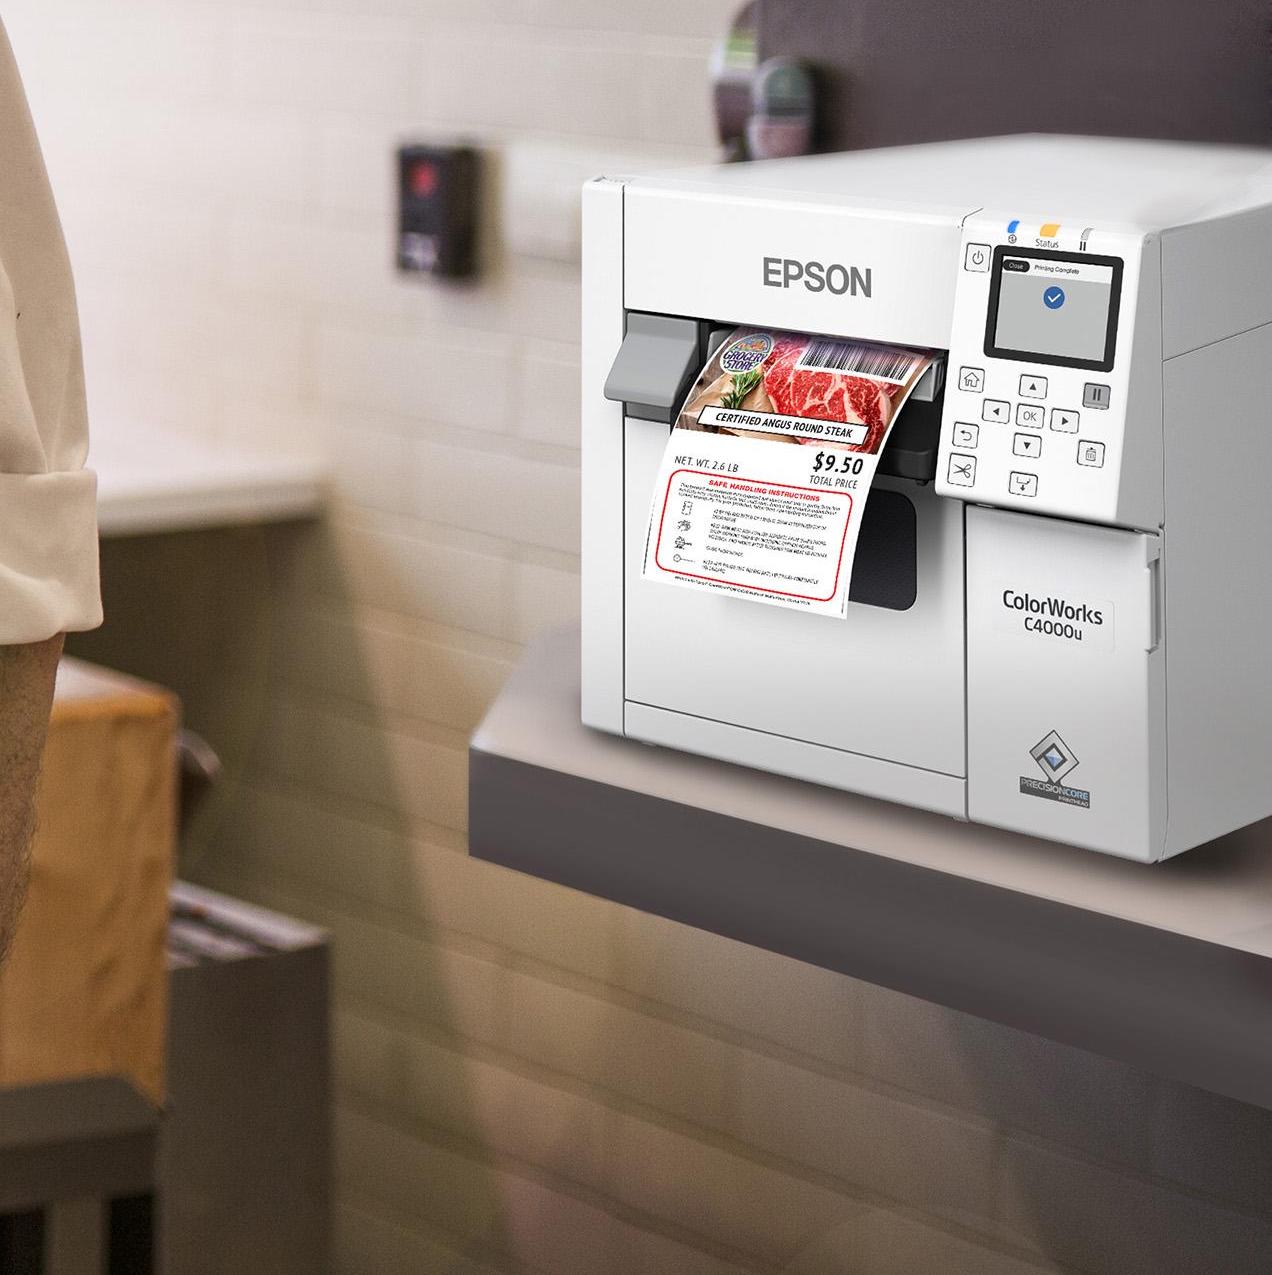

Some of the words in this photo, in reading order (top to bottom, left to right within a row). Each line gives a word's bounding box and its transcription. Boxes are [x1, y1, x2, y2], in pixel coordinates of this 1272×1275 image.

[1035, 238, 1060, 249] Status
[763, 257, 872, 298] EPSON
[1034, 264, 1055, 273] Printing
[1055, 266, 1080, 275] Complete
[723, 350, 768, 363] GROCERY
[724, 359, 755, 371] STORE
[715, 412, 761, 426] CERTIFIED
[762, 418, 793, 431] ANGUS
[793, 421, 824, 434] ROUND
[824, 425, 853, 438] STEAK
[1023, 410, 1037, 422] OK
[674, 455, 694, 466] NET.
[695, 458, 710, 469] WT.
[712, 460, 725, 471] 2.6
[727, 462, 739, 473] LB
[812, 451, 864, 475] $9.50
[708, 479, 727, 488] SAFE
[730, 482, 767, 495] HANDLING
[768, 488, 821, 502] INSTRUCTIONS
[809, 475, 834, 487] TOTAL
[835, 478, 858, 489] PRICE
[1003, 590, 1103, 625] ColorWorks
[1024, 617, 1082, 640] C4000u
[1021, 778, 1089, 801] PRECISIONCORE
